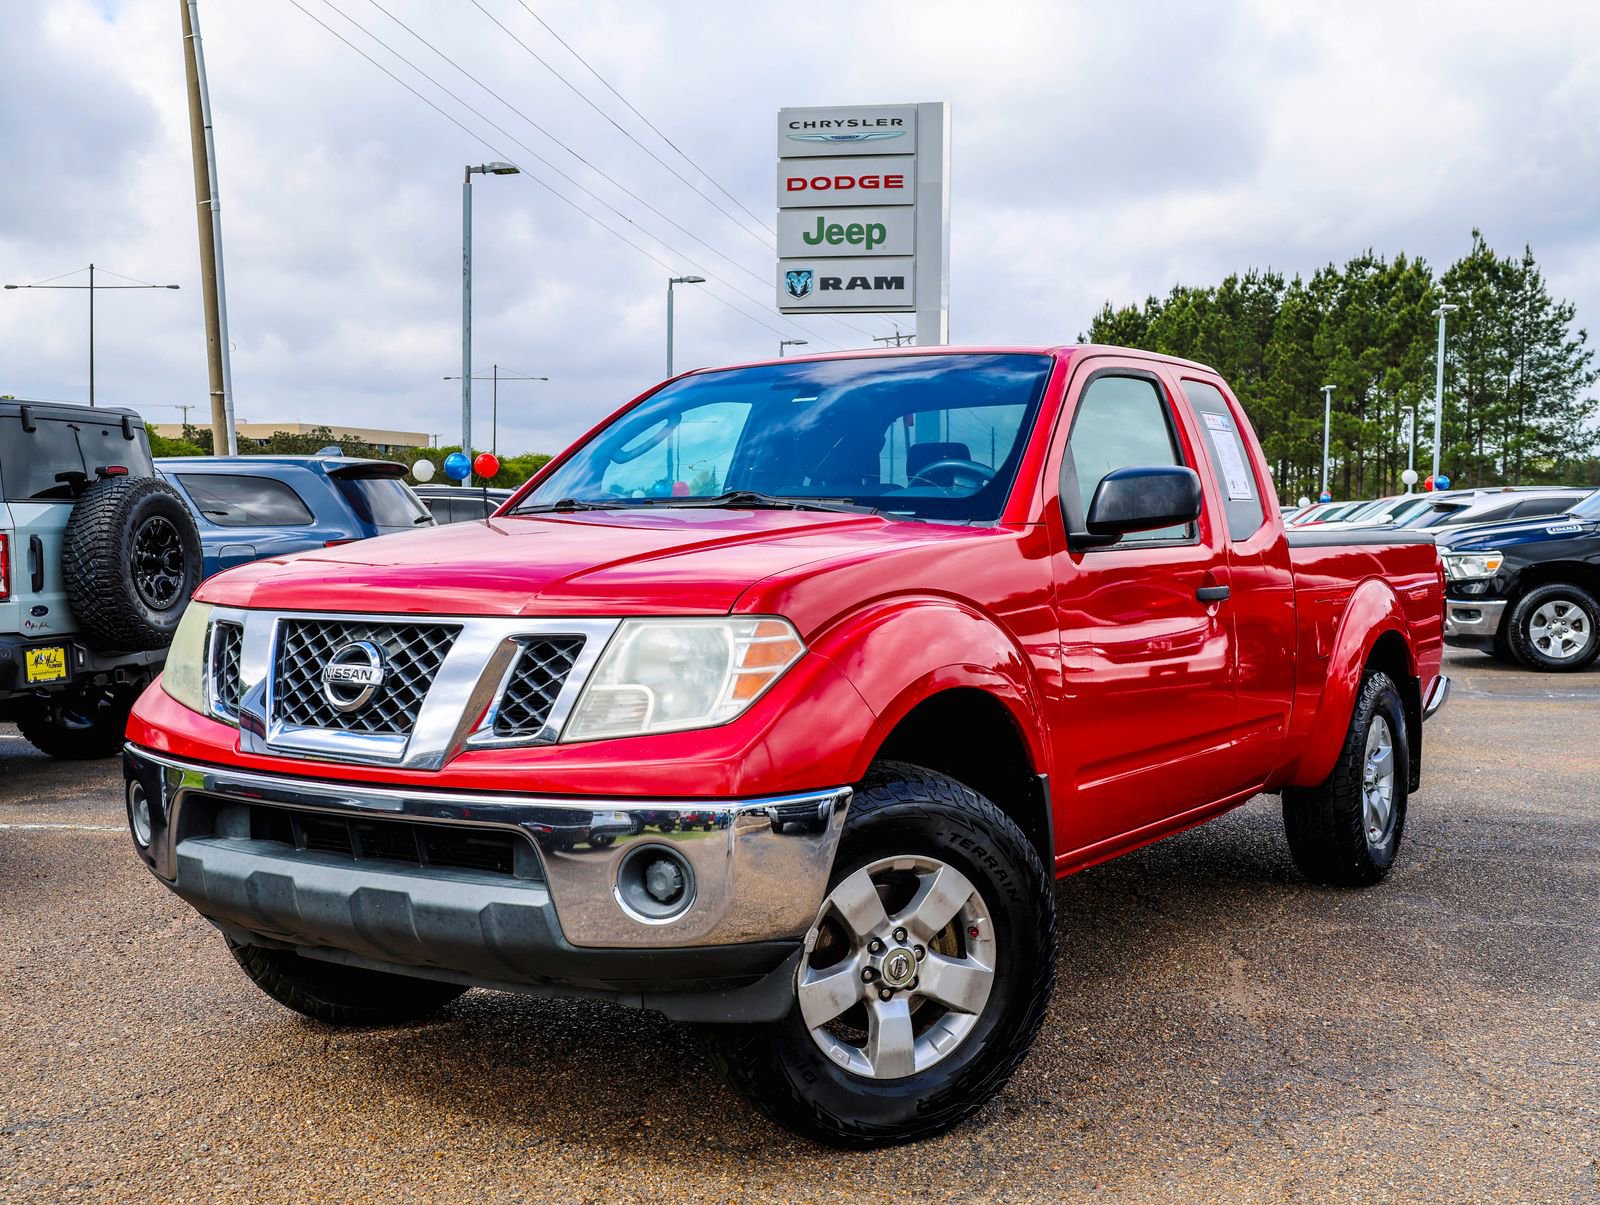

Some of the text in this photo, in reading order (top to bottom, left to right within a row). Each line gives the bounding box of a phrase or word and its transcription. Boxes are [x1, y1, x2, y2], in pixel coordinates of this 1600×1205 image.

[789, 118, 904, 130] CHRYSLER
[787, 175, 904, 191] DODGE
[803, 216, 887, 250] Jeep
[819, 276, 904, 290] RAM
[324, 667, 373, 681] NISSAN
